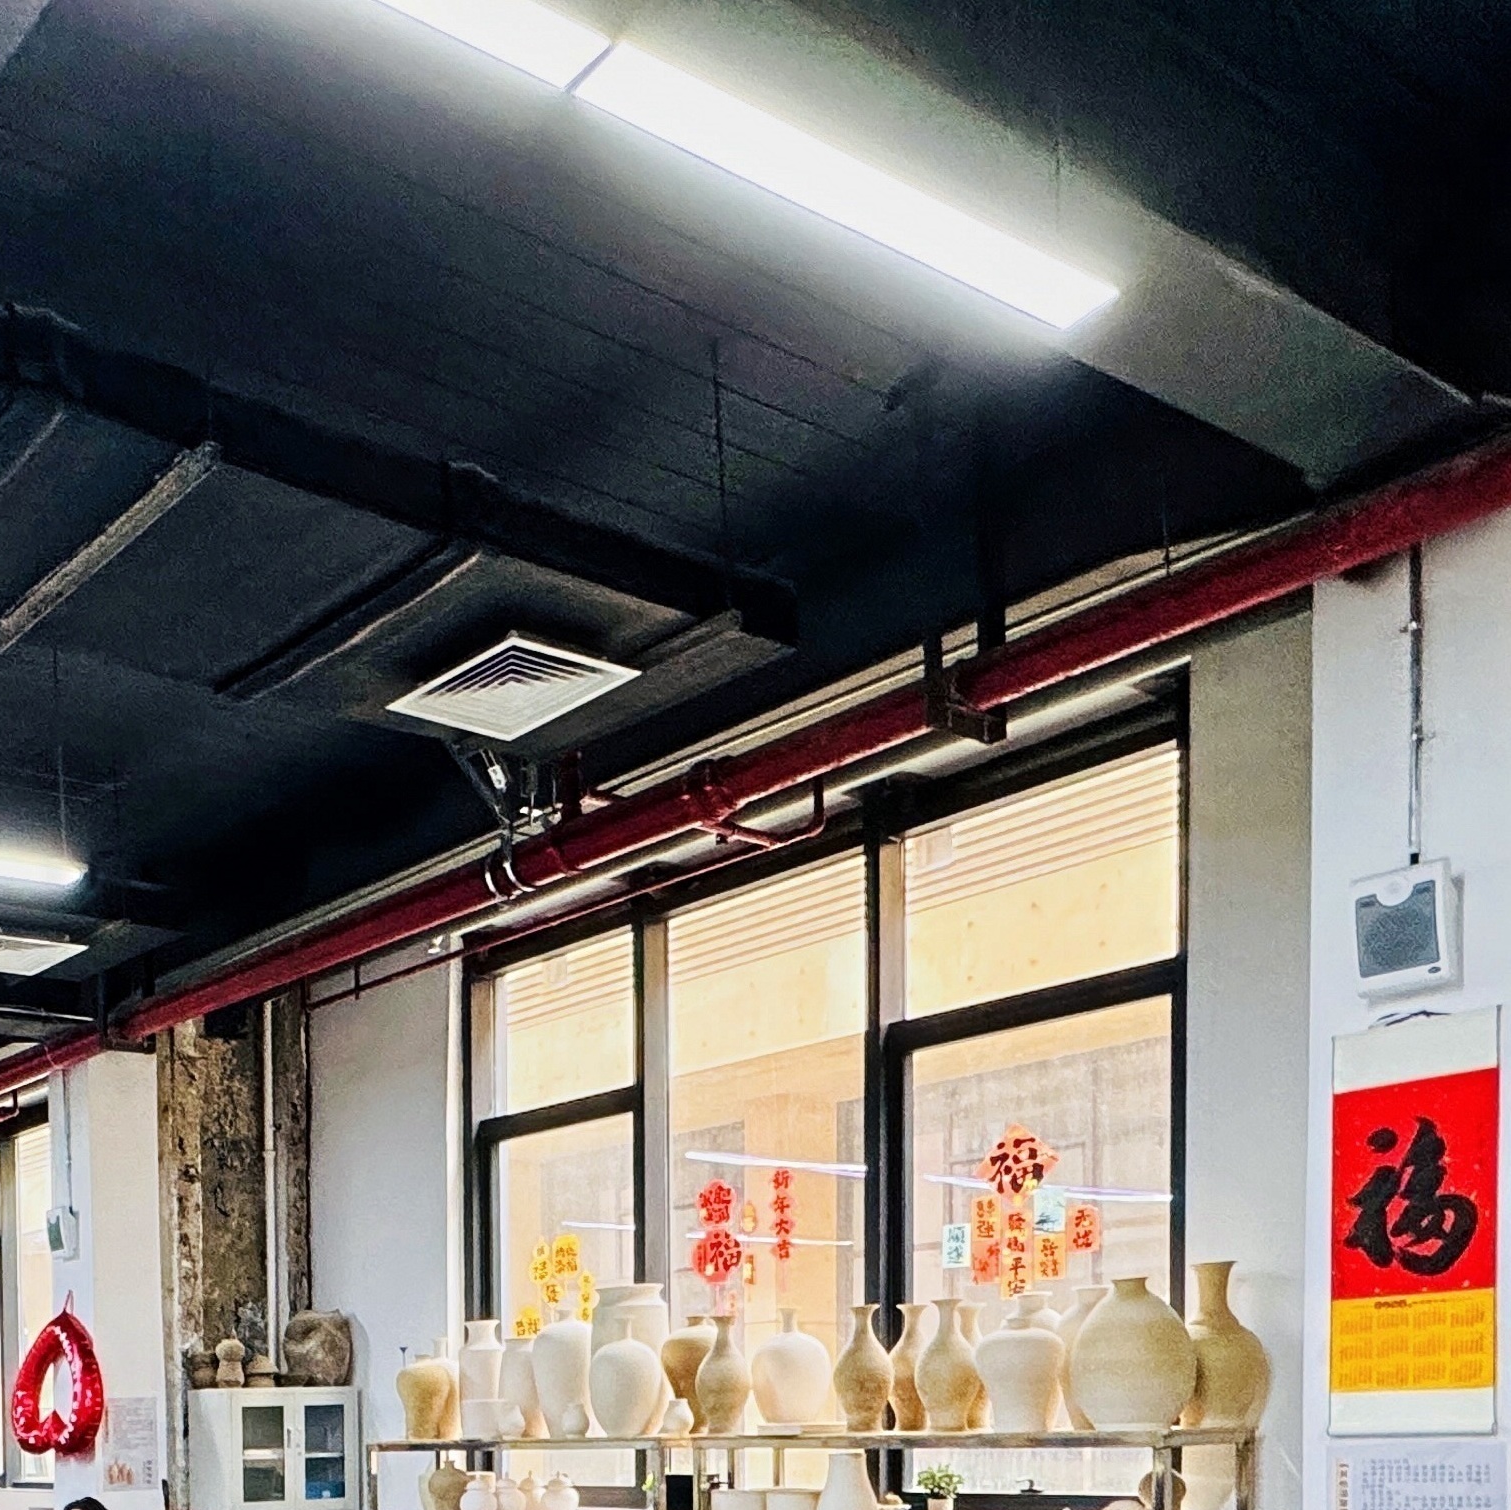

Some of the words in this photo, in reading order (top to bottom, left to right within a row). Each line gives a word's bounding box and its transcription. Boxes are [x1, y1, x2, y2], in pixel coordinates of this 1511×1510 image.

[989, 1136, 1045, 1194] 福
[1343, 1115, 1478, 1277] 福
[709, 1231, 742, 1272] 福
[772, 1169, 791, 1260] 新年大吉
